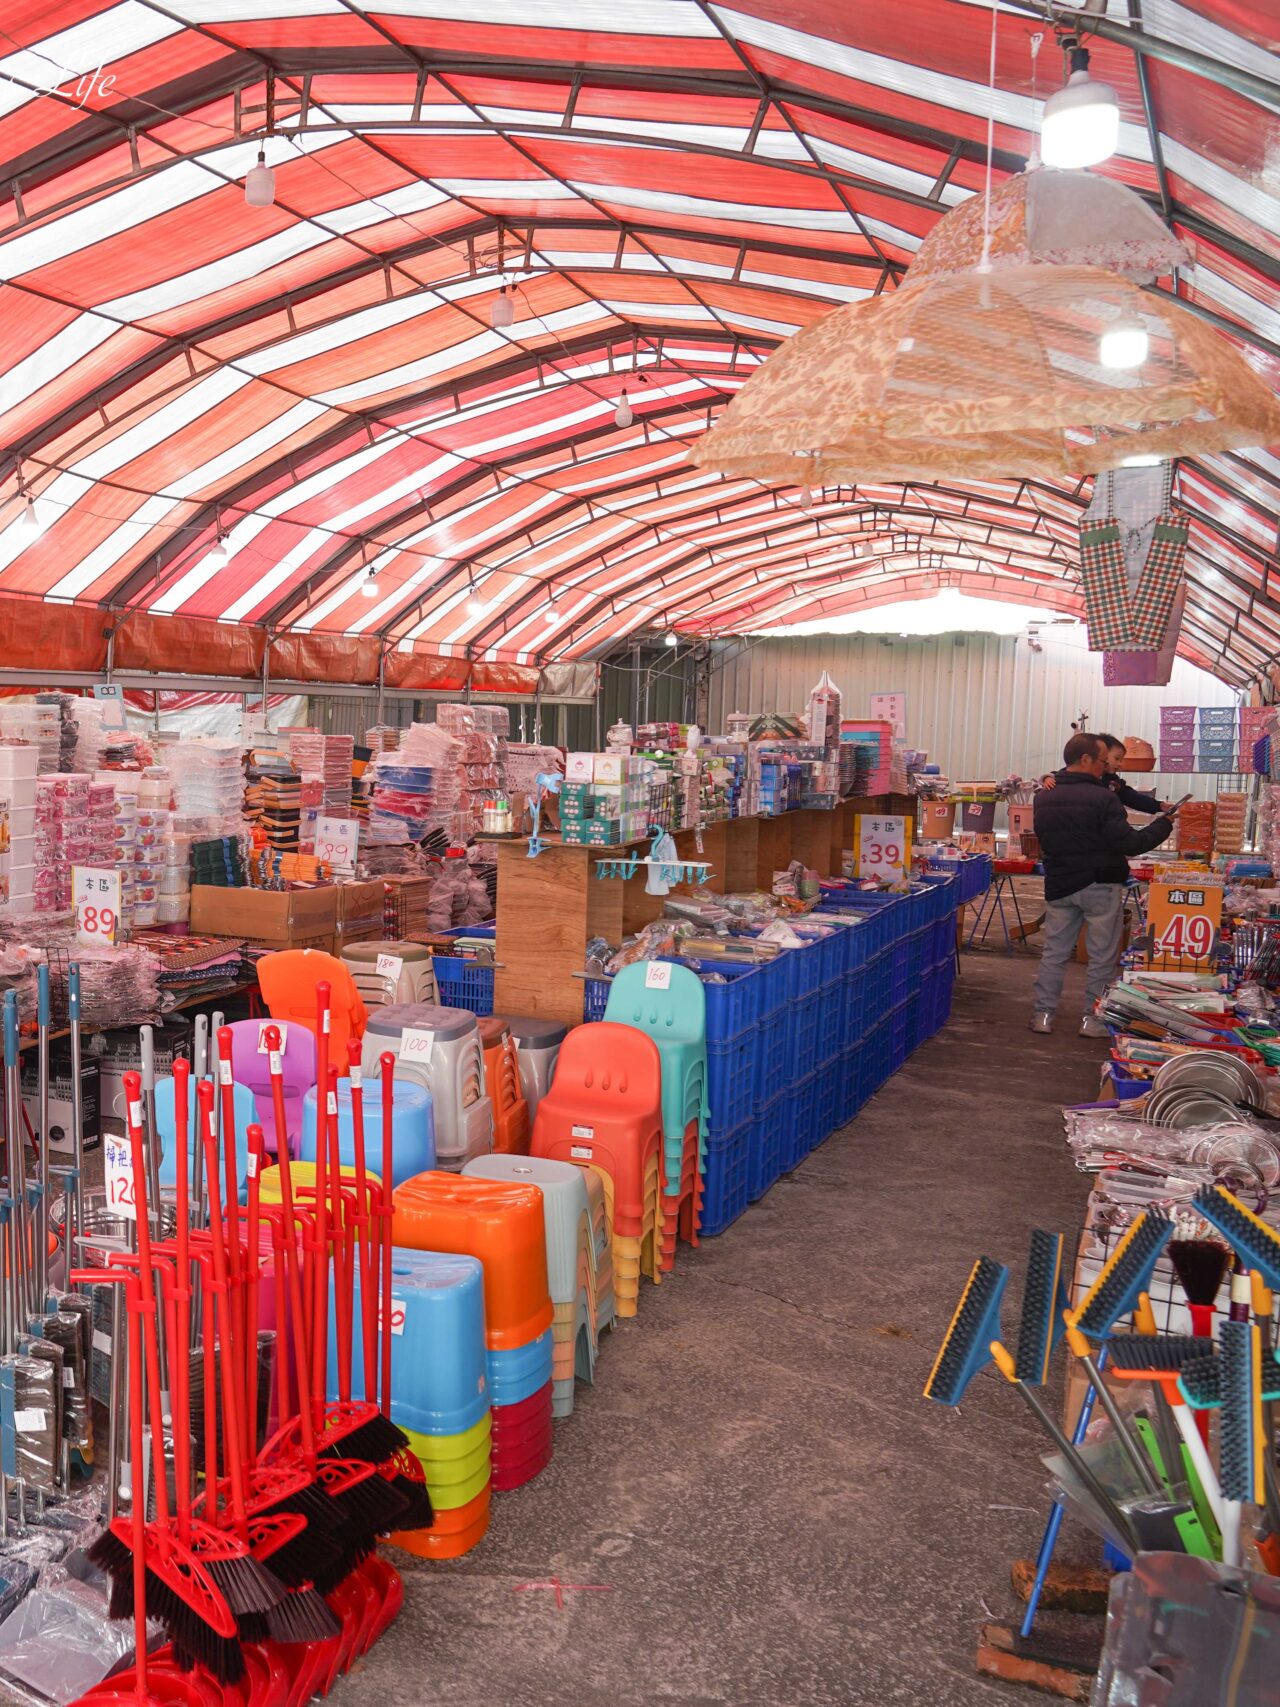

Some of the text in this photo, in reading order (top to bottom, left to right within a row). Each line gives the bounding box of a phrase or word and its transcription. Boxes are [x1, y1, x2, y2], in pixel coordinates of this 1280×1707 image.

[85, 878, 110, 892] 本區
[1167, 889, 1206, 907] 本區
[404, 1037, 428, 1052] 100
[106, 1143, 133, 1169] 掃把
